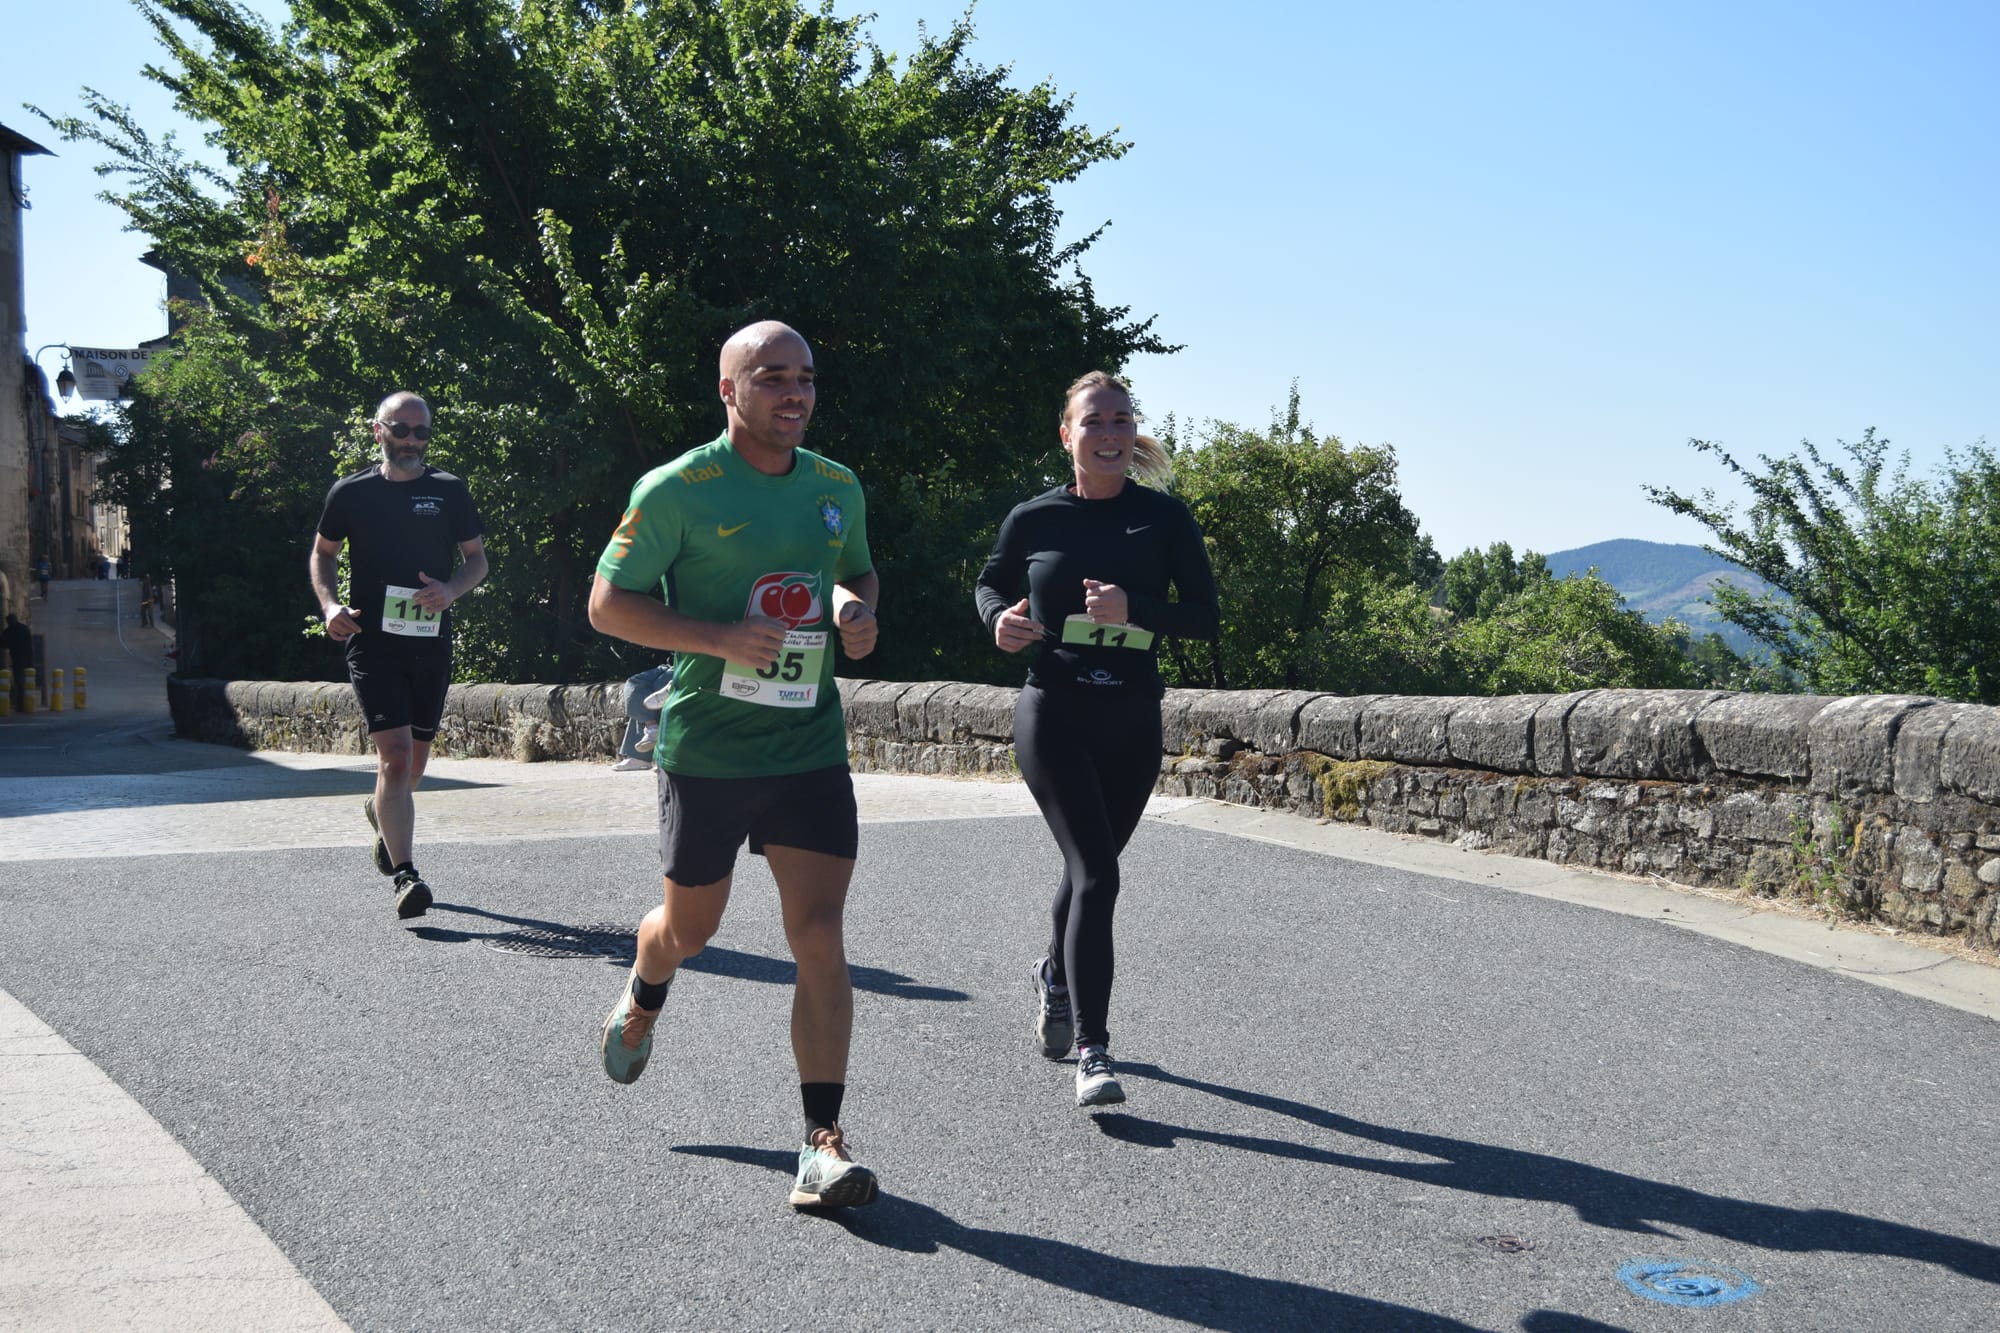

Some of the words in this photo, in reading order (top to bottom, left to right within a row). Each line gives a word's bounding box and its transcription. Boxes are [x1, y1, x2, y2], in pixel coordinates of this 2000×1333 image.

[75, 350, 128, 360] MAISON
[131, 350, 149, 360] DE
[1088, 628, 1128, 648] 11
